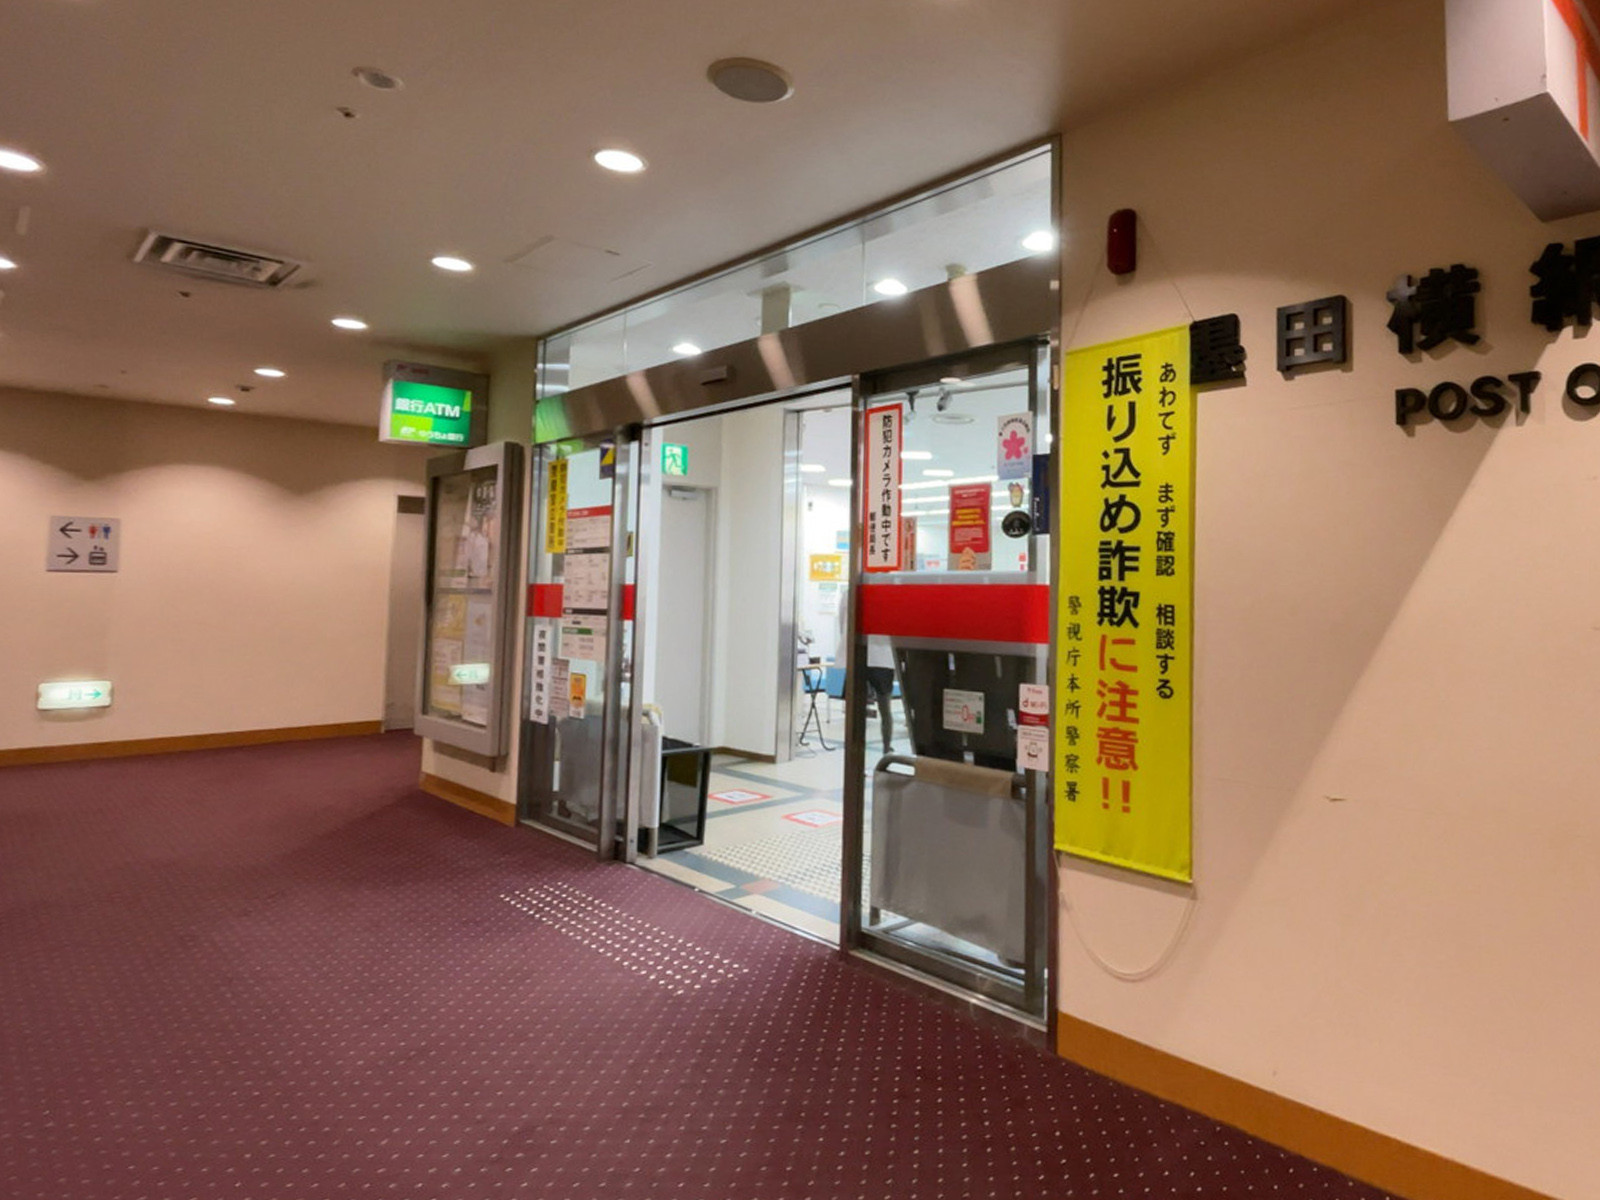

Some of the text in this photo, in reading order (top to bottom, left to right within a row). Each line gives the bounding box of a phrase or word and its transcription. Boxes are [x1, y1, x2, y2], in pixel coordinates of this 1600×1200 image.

[394, 397, 460, 419] 銀行ATM
[1396, 371, 1541, 426] POST
[880, 414, 892, 563] 防犯カメラ作動中です
[1155, 362, 1177, 700] あわてず まず確認 相談する
[1063, 595, 1083, 803] 警視庁本所警察署
